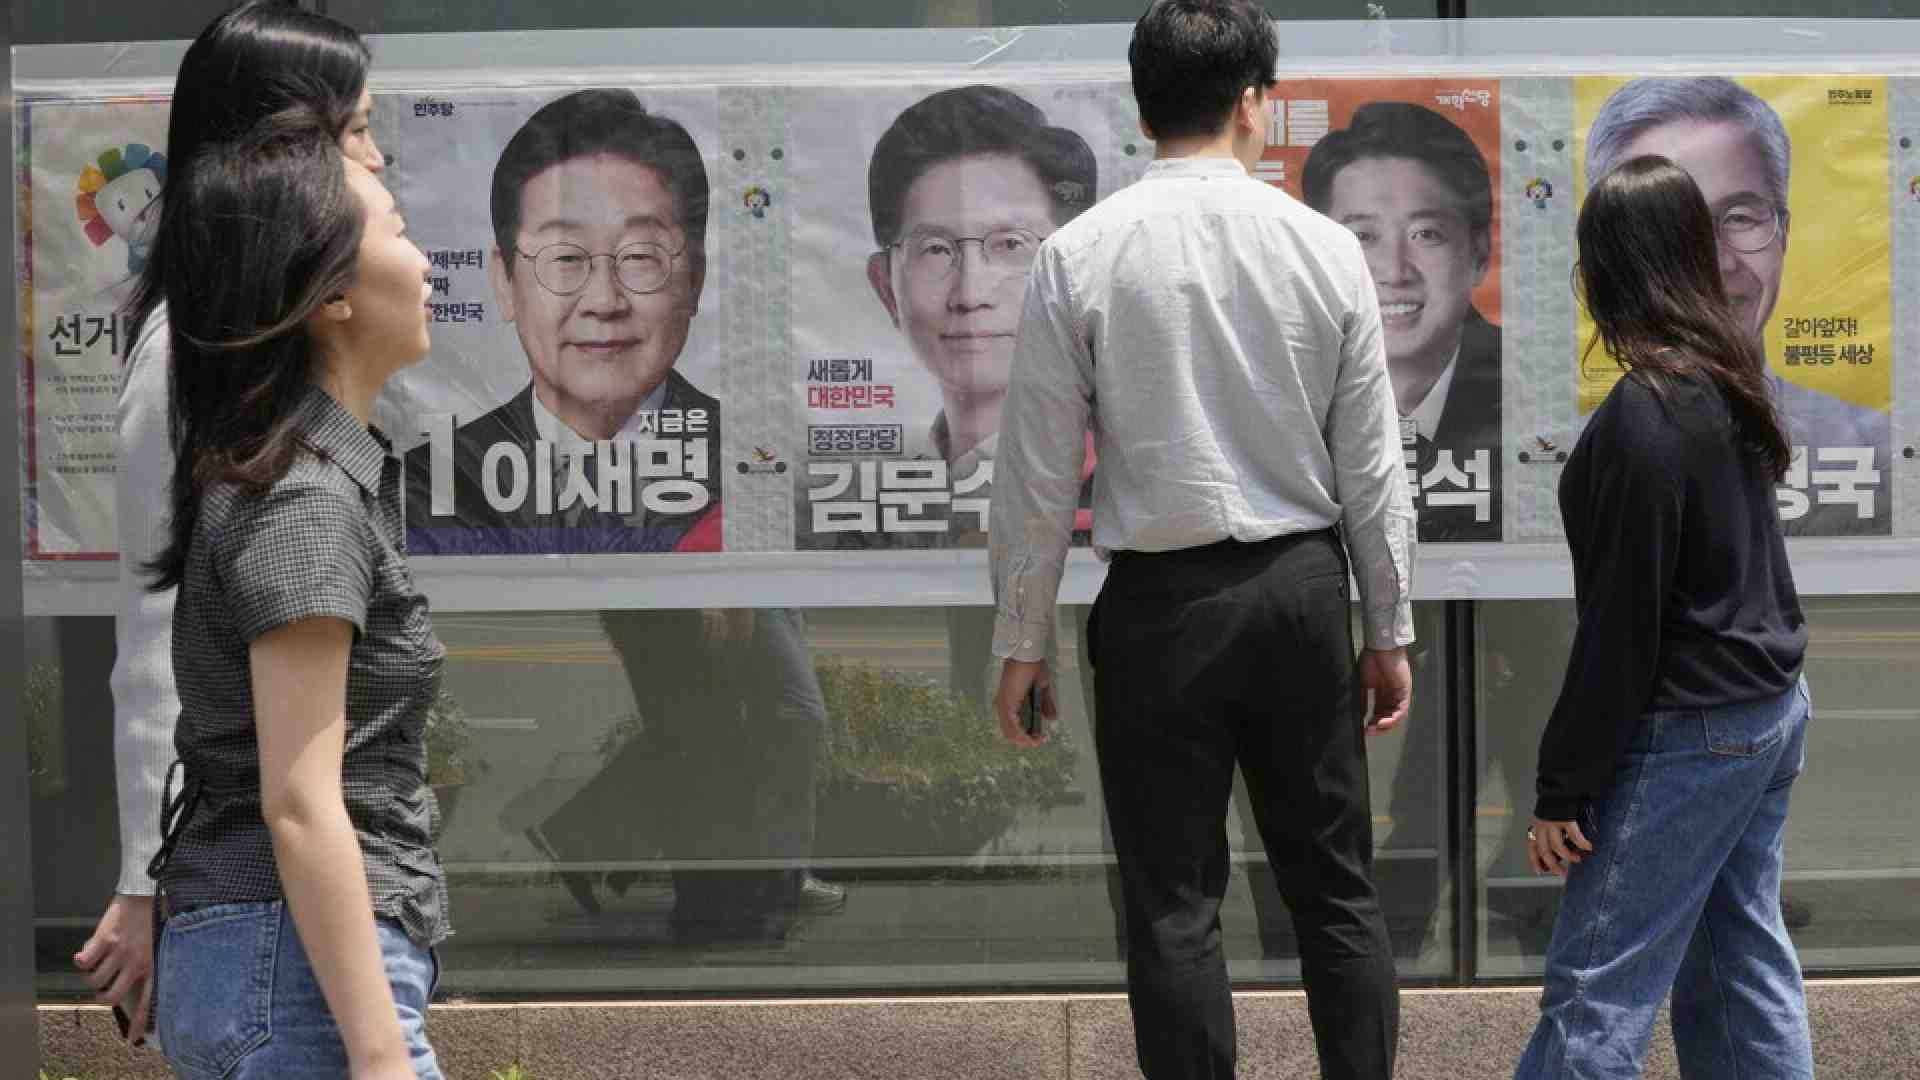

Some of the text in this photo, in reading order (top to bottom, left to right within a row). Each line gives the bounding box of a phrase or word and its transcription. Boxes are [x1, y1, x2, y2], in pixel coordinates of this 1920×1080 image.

[414, 102, 455, 116] 민주당
[426, 276, 449, 296] 짜
[427, 302, 483, 322] 한민국
[48, 313, 128, 355] 선거
[1784, 317, 1857, 338] 갈아엎자!
[1784, 343, 1875, 366] 불평등 세상
[807, 359, 872, 382] 새롭게
[807, 384, 896, 409] 대한민국
[639, 408, 709, 433] 지금은
[813, 428, 898, 451] 정정당당
[419, 414, 710, 516] 1 이재명
[1405, 449, 1490, 522] 석
